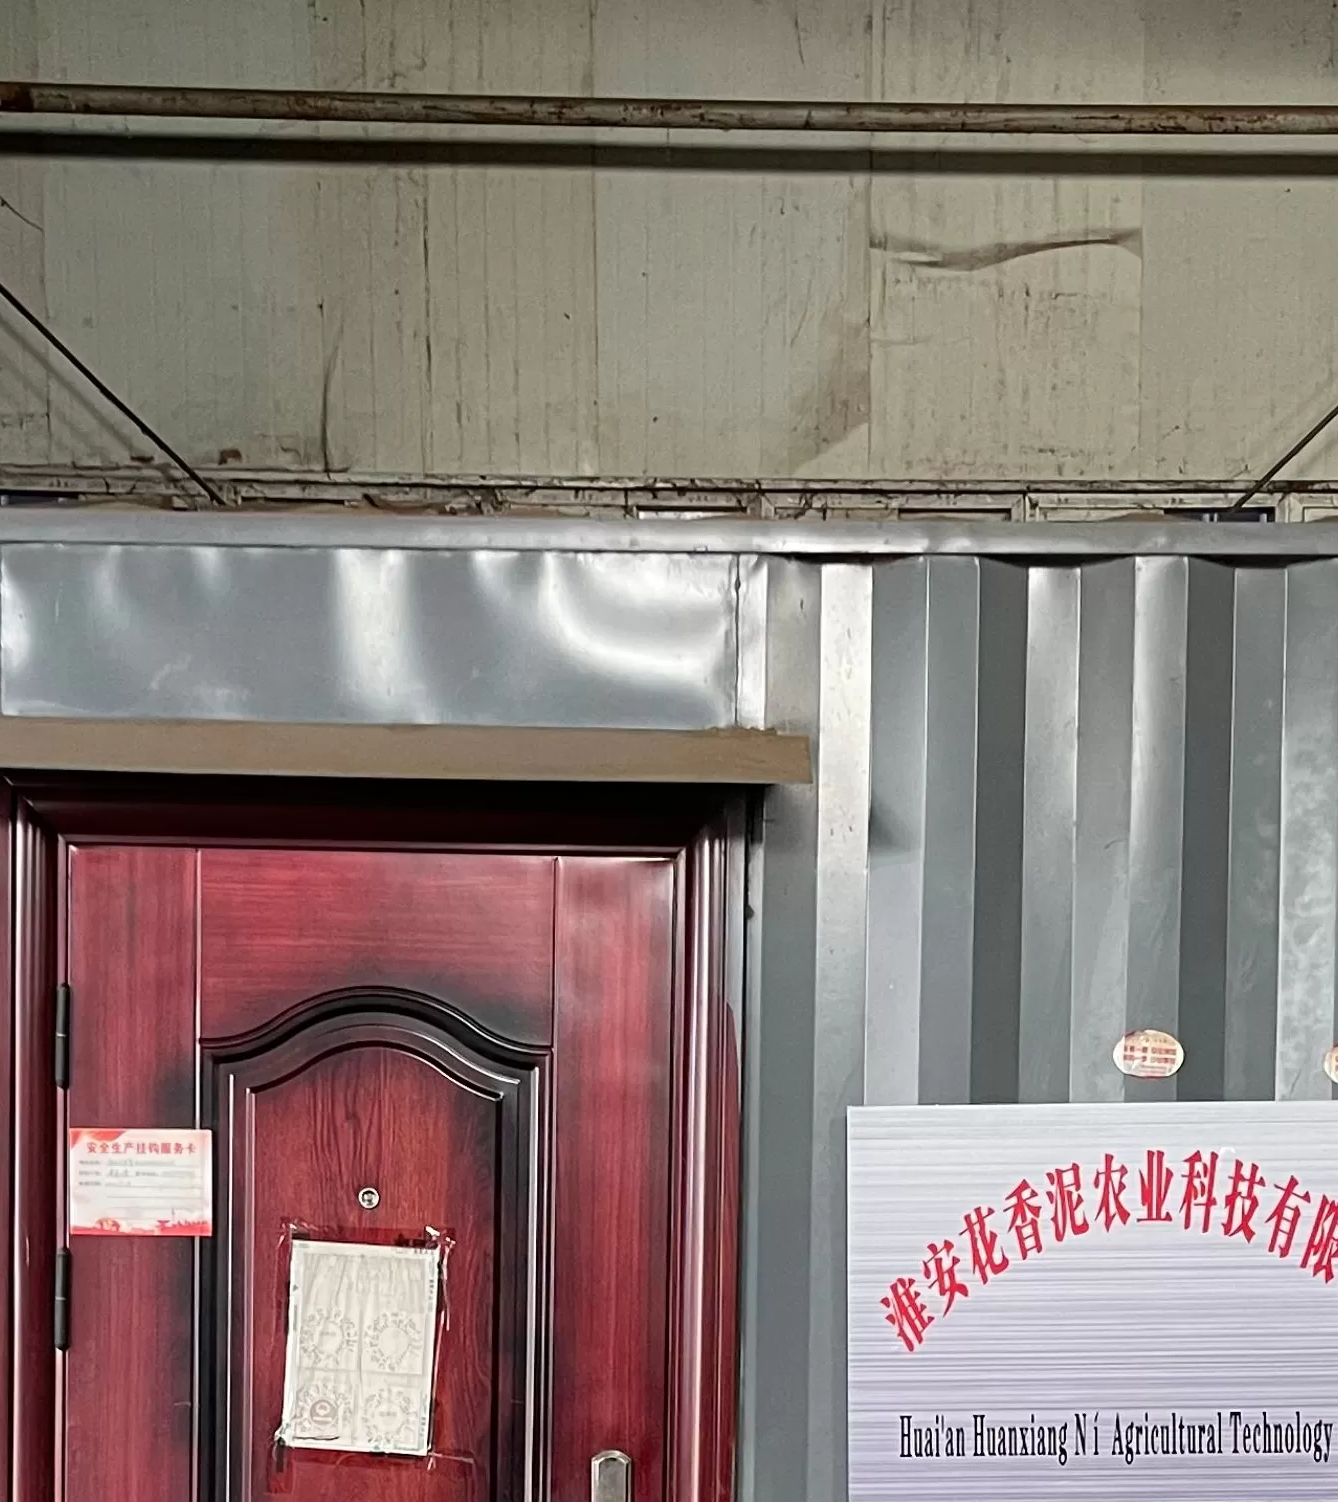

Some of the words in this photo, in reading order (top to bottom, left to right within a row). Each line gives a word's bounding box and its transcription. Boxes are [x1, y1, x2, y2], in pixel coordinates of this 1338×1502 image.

[899, 1414, 966, 1459] Huai'an
[972, 1414, 1068, 1466] Huanxiang
[1111, 1412, 1223, 1463] Agricultural
[1229, 1412, 1333, 1463] Technology
